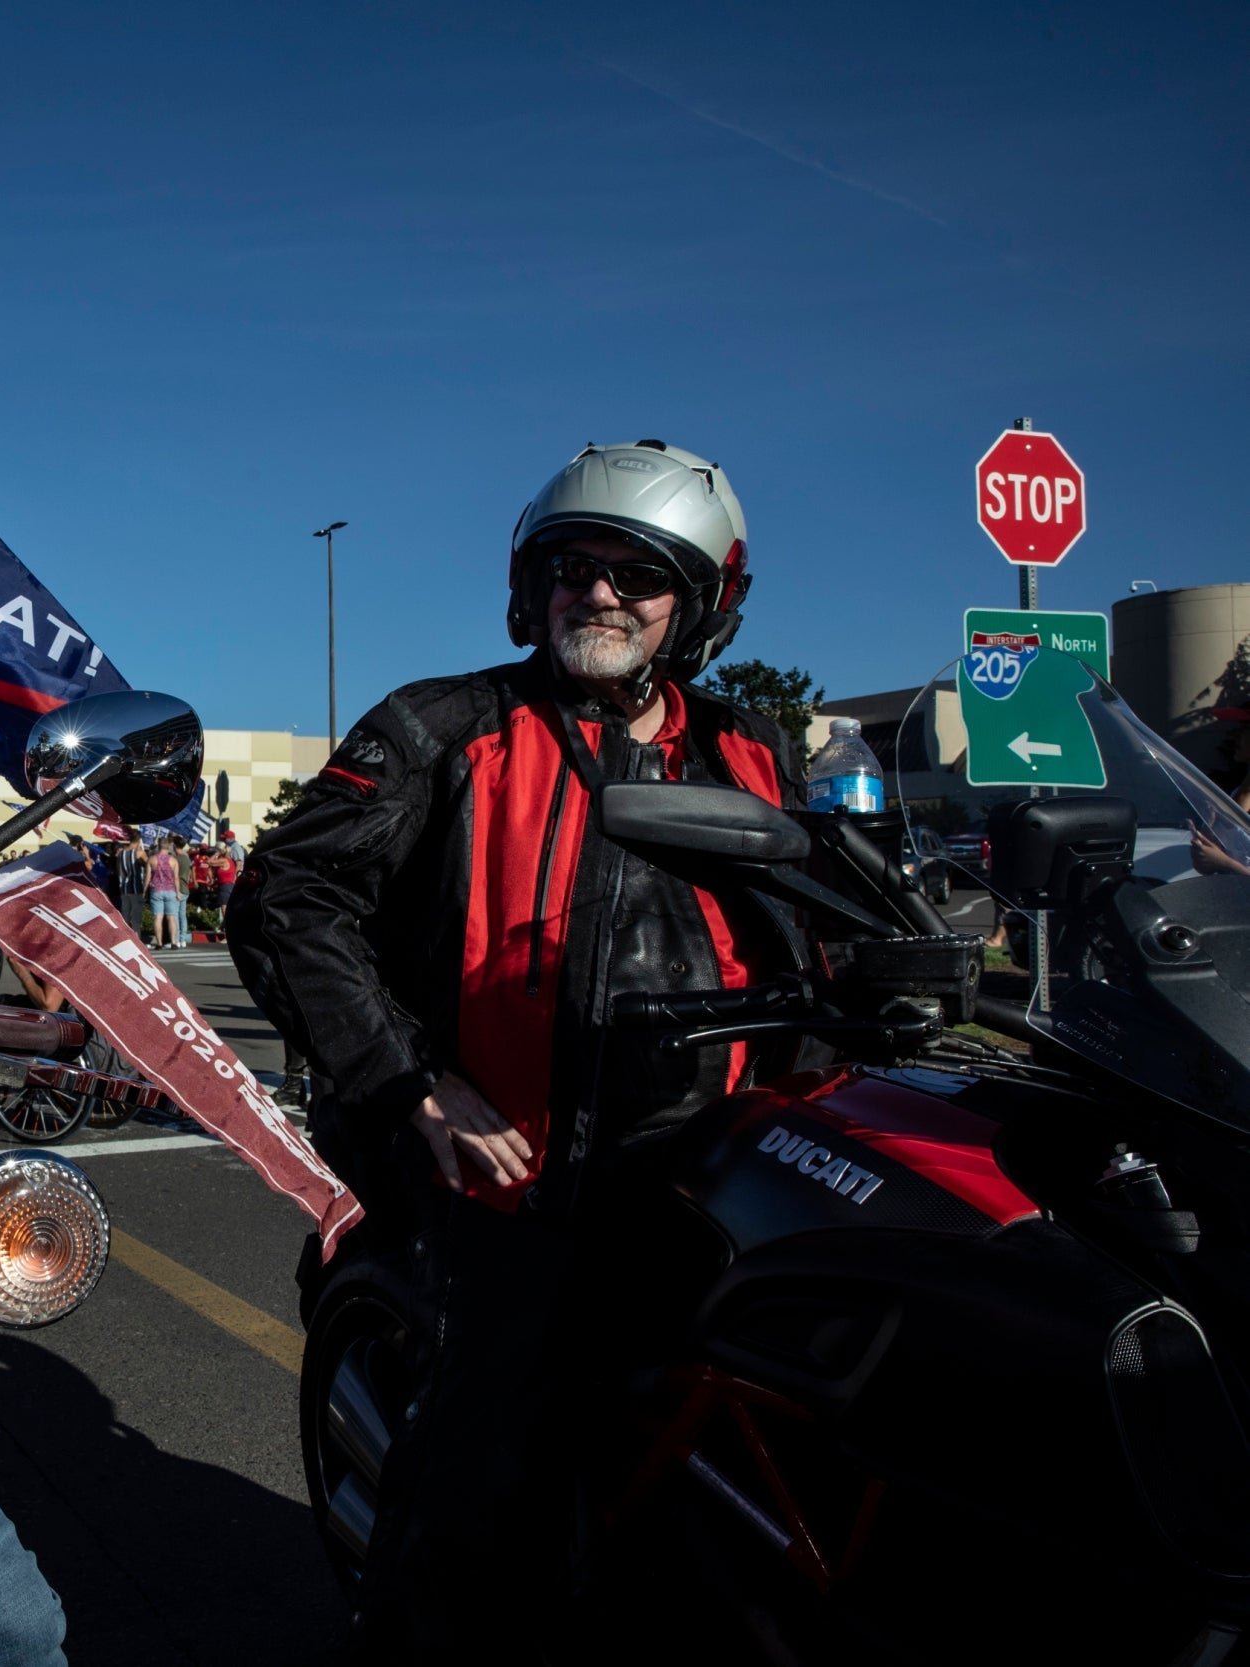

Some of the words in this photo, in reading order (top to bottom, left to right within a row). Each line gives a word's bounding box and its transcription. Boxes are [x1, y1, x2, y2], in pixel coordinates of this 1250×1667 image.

[616, 460, 653, 472] BELL
[985, 472, 1076, 524] STOP
[986, 636, 1026, 645] INTERSTATE
[1051, 633, 1097, 652] NORTH
[971, 651, 1020, 684] 205
[348, 734, 383, 759] OCKET
[150, 1001, 235, 1080] 2020
[757, 1126, 885, 1205] DUCATI
